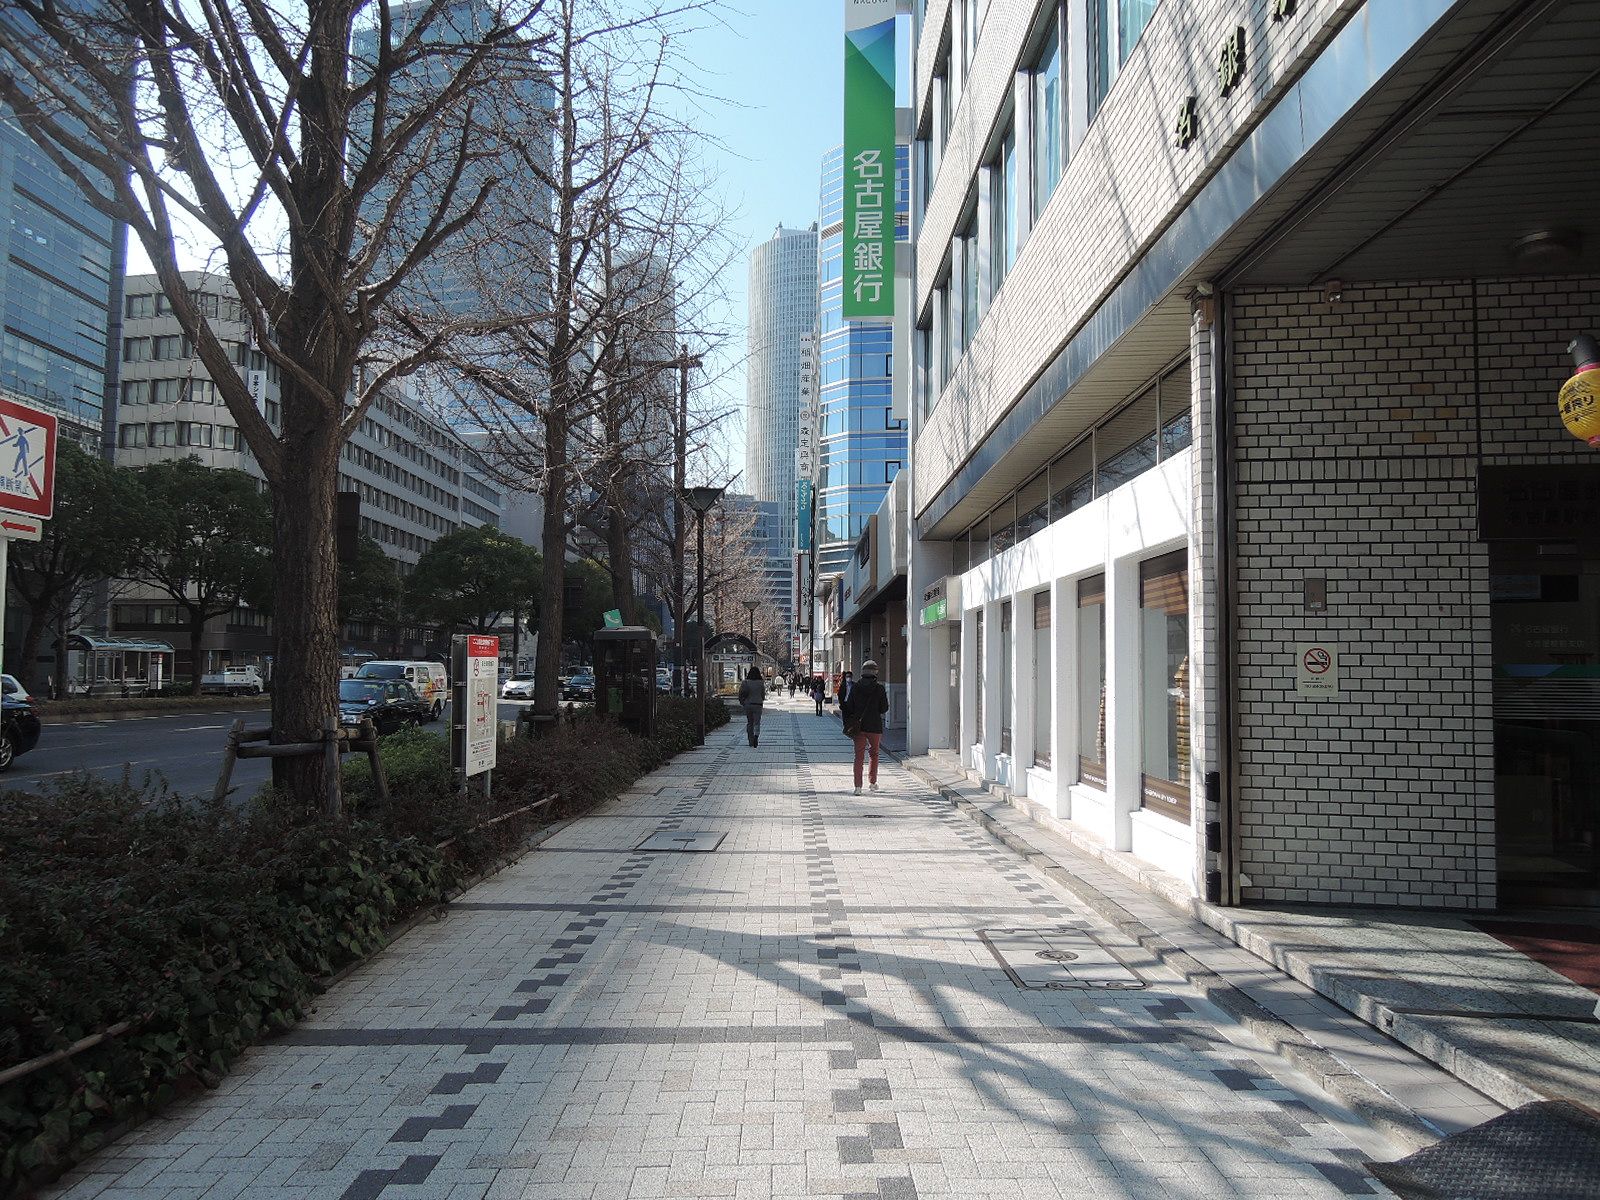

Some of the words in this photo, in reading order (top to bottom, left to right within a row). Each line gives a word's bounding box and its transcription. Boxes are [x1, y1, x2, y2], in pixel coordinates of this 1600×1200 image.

[853, 149, 884, 303] 名古屋銀行
